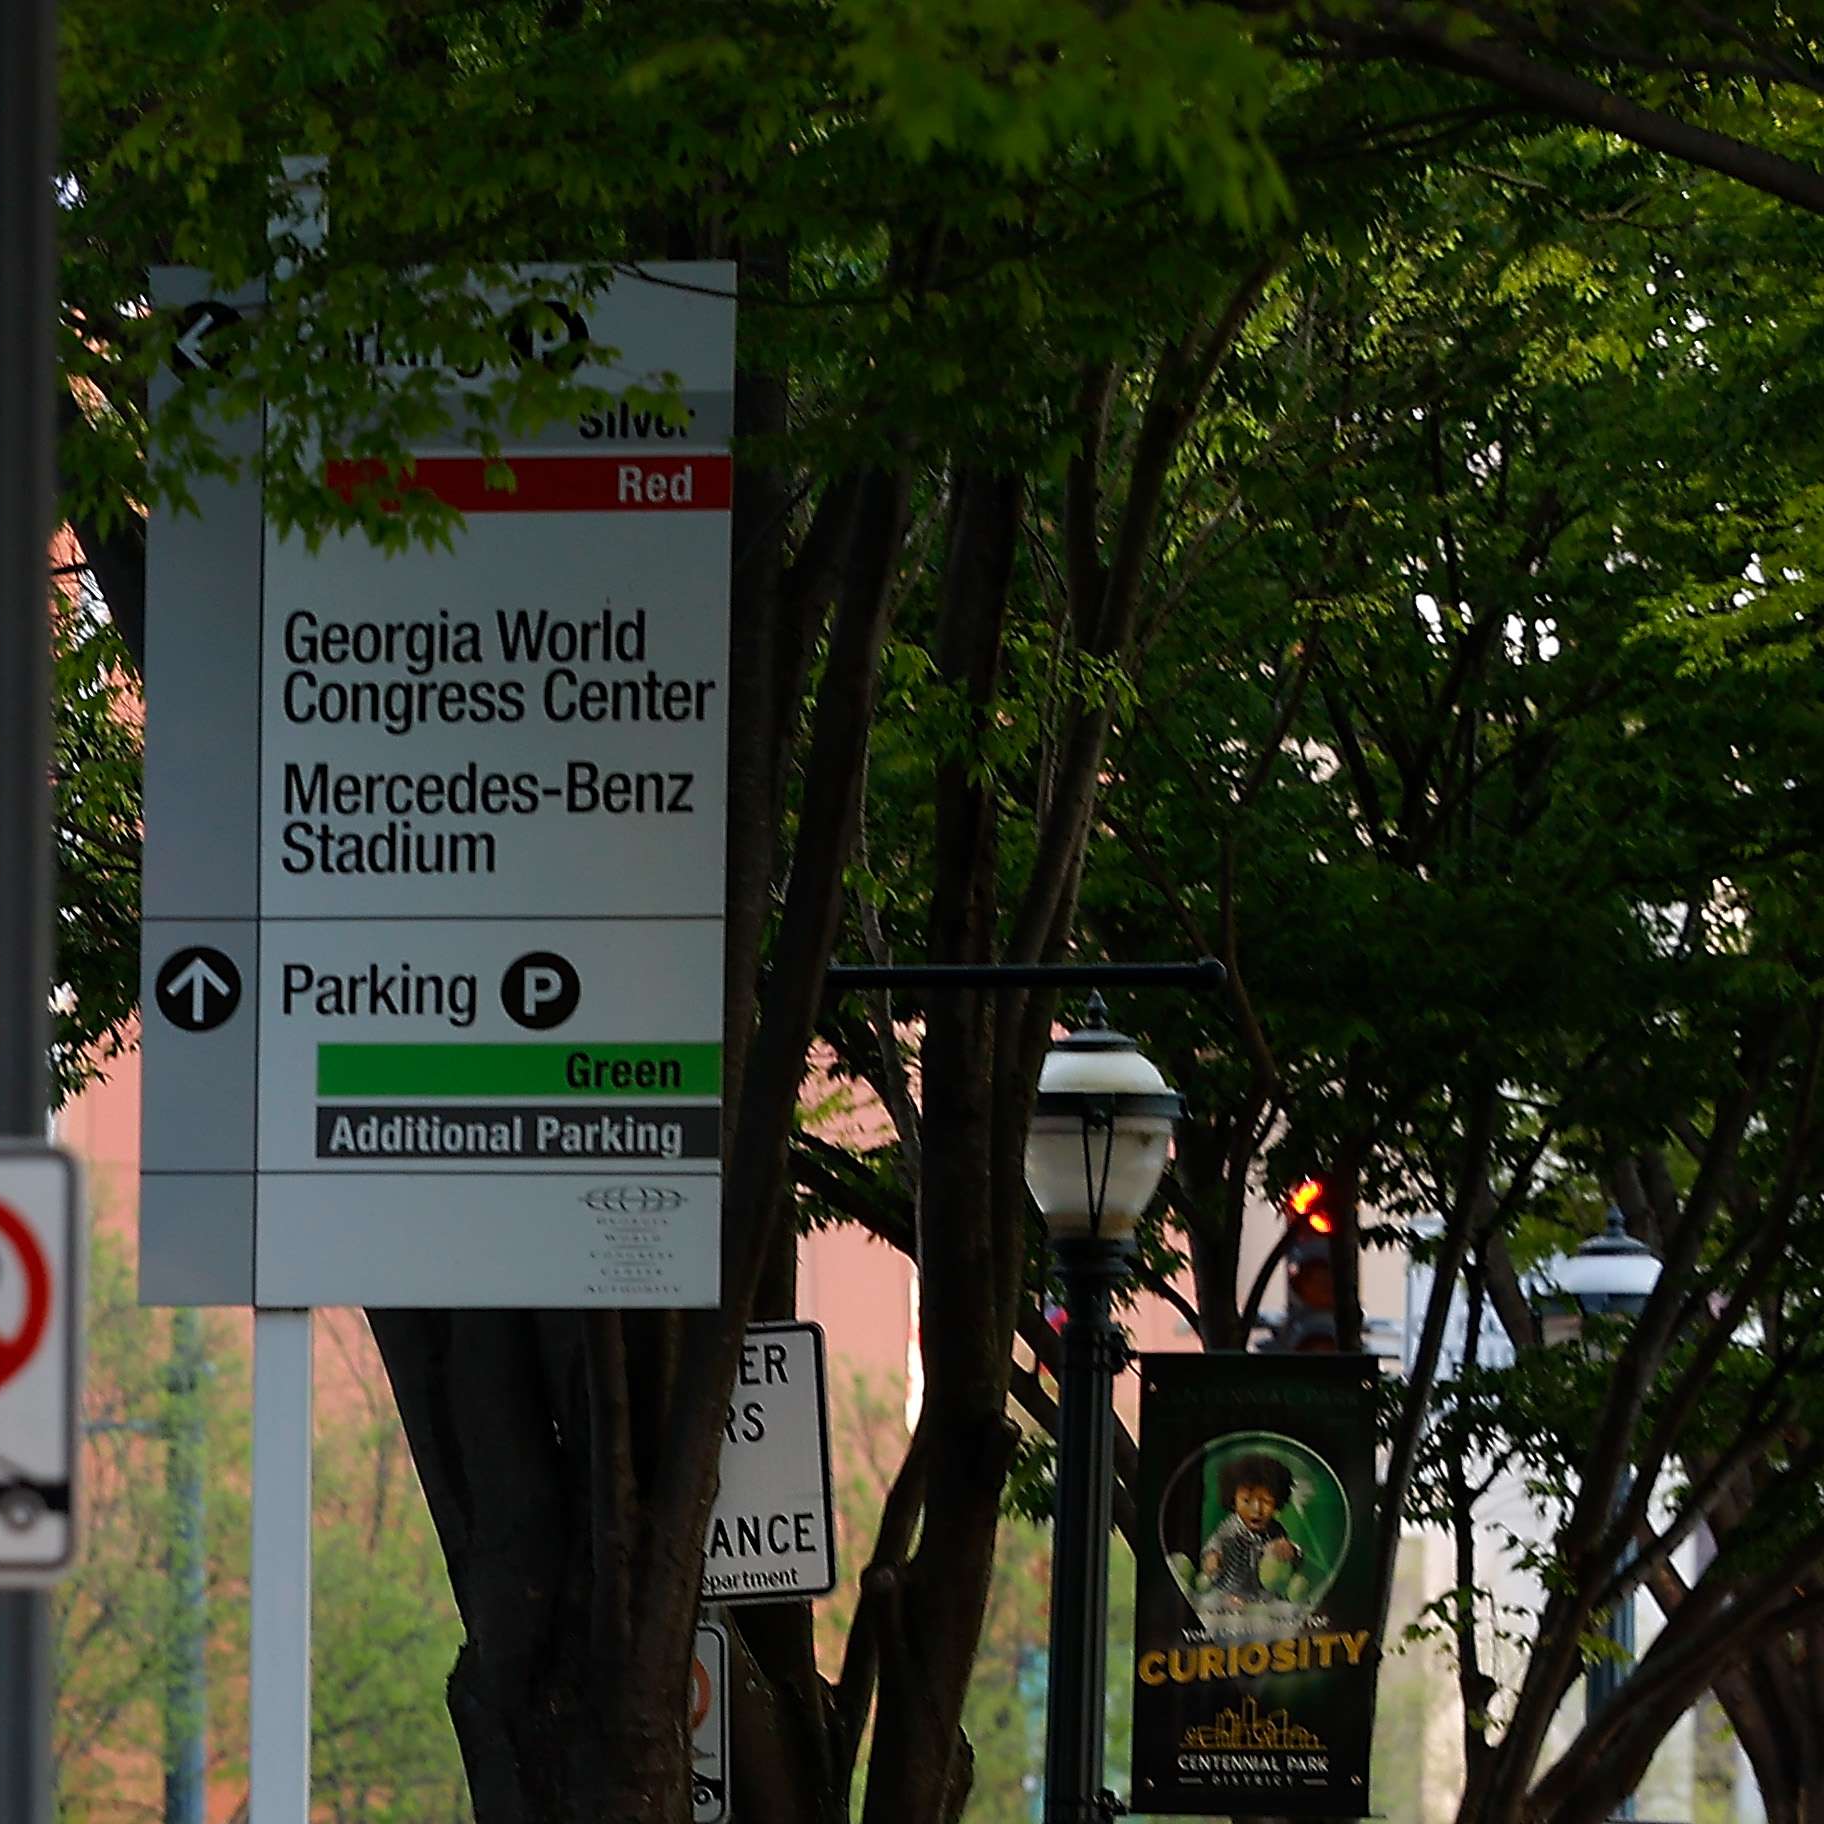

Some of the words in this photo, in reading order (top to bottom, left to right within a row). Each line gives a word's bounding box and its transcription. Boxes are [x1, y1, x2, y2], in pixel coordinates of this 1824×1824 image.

[578, 399, 695, 440] Silve
[617, 464, 693, 503] Red
[284, 610, 482, 675] Georgia
[496, 609, 645, 663] World
[284, 670, 525, 734] Congress
[544, 668, 715, 721] Center
[284, 761, 693, 814] Mercedes-Benz
[282, 821, 495, 874] Stadium
[282, 962, 478, 1027] Parking
[566, 1051, 681, 1088] Green
[330, 1116, 522, 1153] Additional
[536, 1116, 683, 1159] Parking
[739, 1343, 788, 1385] ER
[707, 1513, 817, 1559] ANCE
[703, 1567, 798, 1594] epartment
[1138, 1629, 1371, 1687] CURIOSITY
[1177, 1754, 1282, 1772] CENTENNIAL
[1286, 1755, 1330, 1773] PARK
